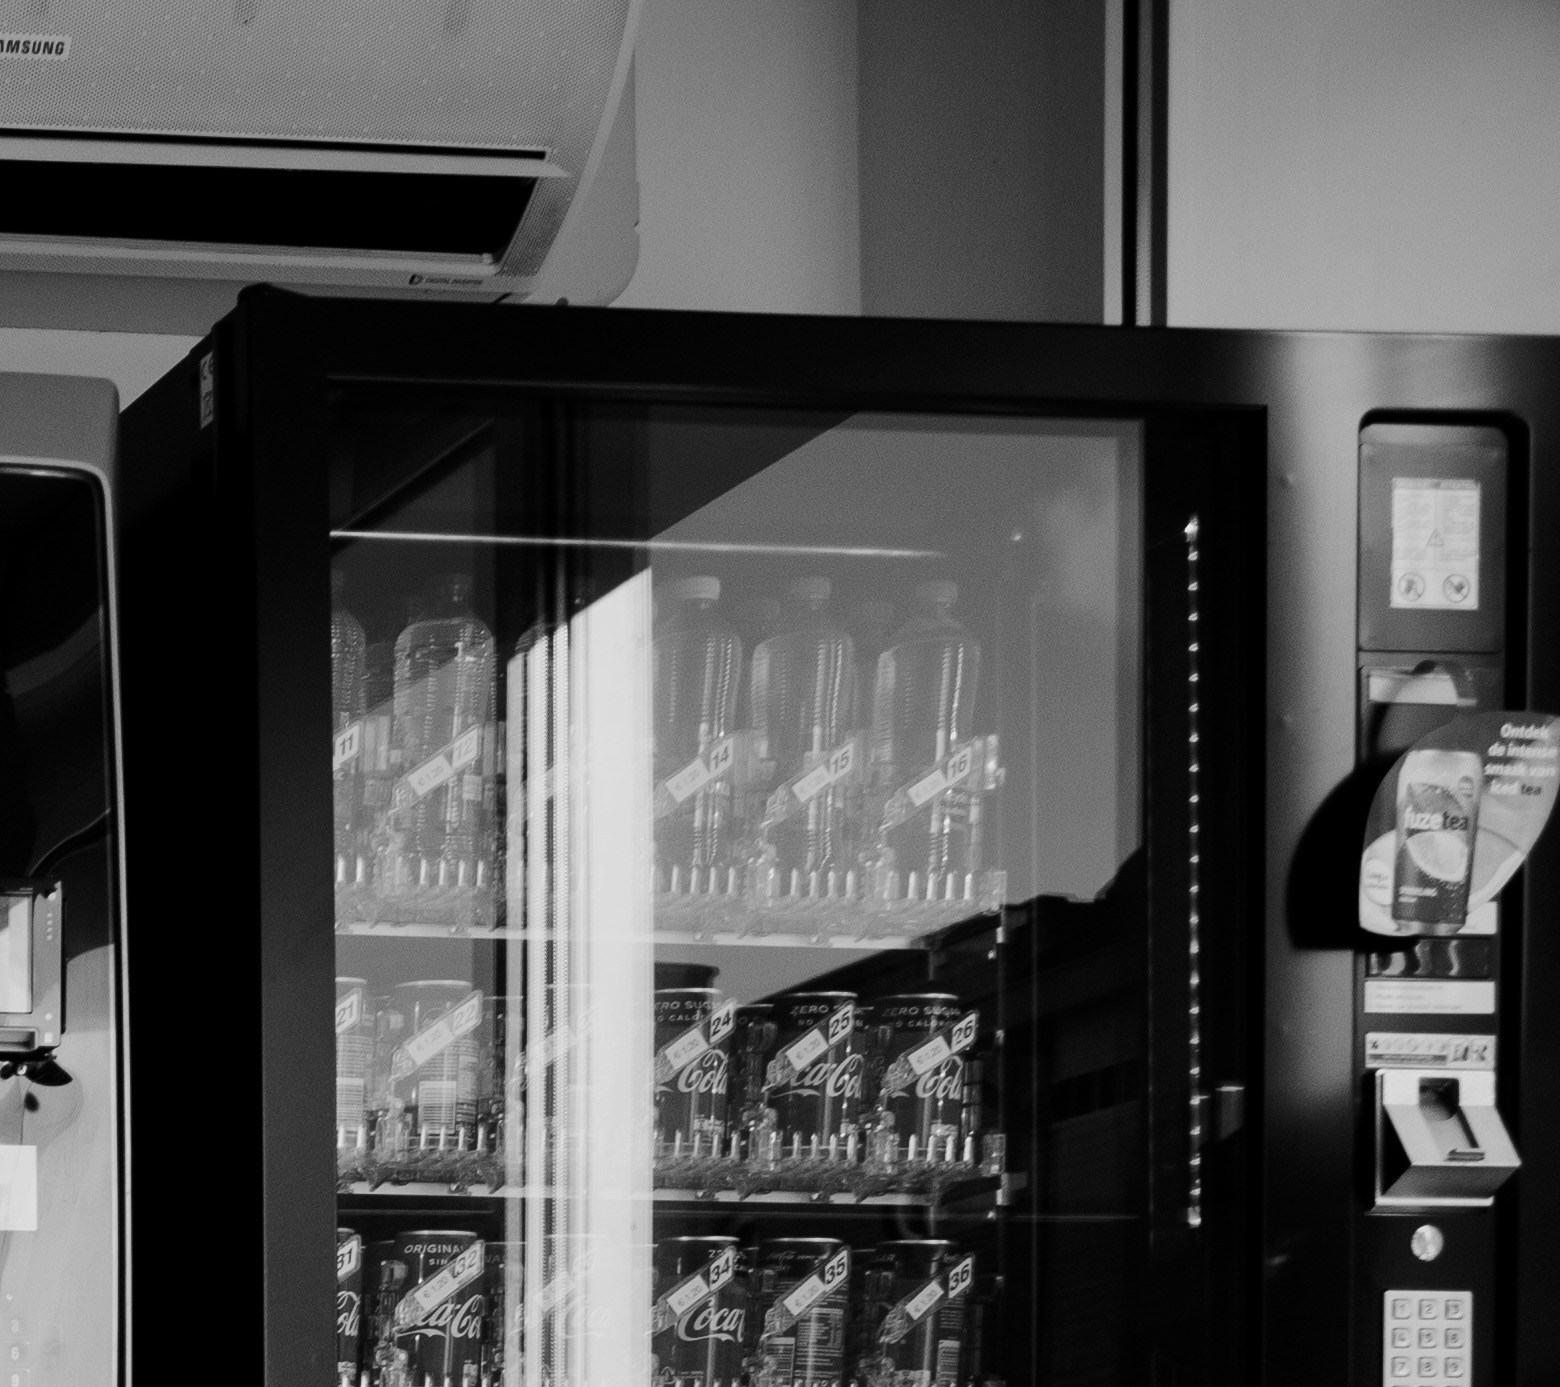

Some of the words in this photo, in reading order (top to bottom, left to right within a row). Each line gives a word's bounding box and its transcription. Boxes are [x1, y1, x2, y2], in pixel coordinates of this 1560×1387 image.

[1501, 723, 1550, 739] Ontdek
[338, 734, 354, 755] 11
[1488, 744, 1505, 756] de
[1506, 744, 1557, 759] intense
[711, 747, 730, 770] 14
[831, 751, 850, 774] 15
[947, 756, 967, 777] 16
[1485, 763, 1527, 776] smaak
[1529, 764, 1556, 777] van
[1520, 782, 1542, 796] tea
[711, 1011, 731, 1035] 24
[829, 1012, 850, 1037] 25
[953, 1019, 973, 1045] 26
[453, 1250, 477, 1277] 32
[711, 1259, 731, 1285] 34
[825, 1260, 846, 1285] 35
[949, 1266, 969, 1292] 36
